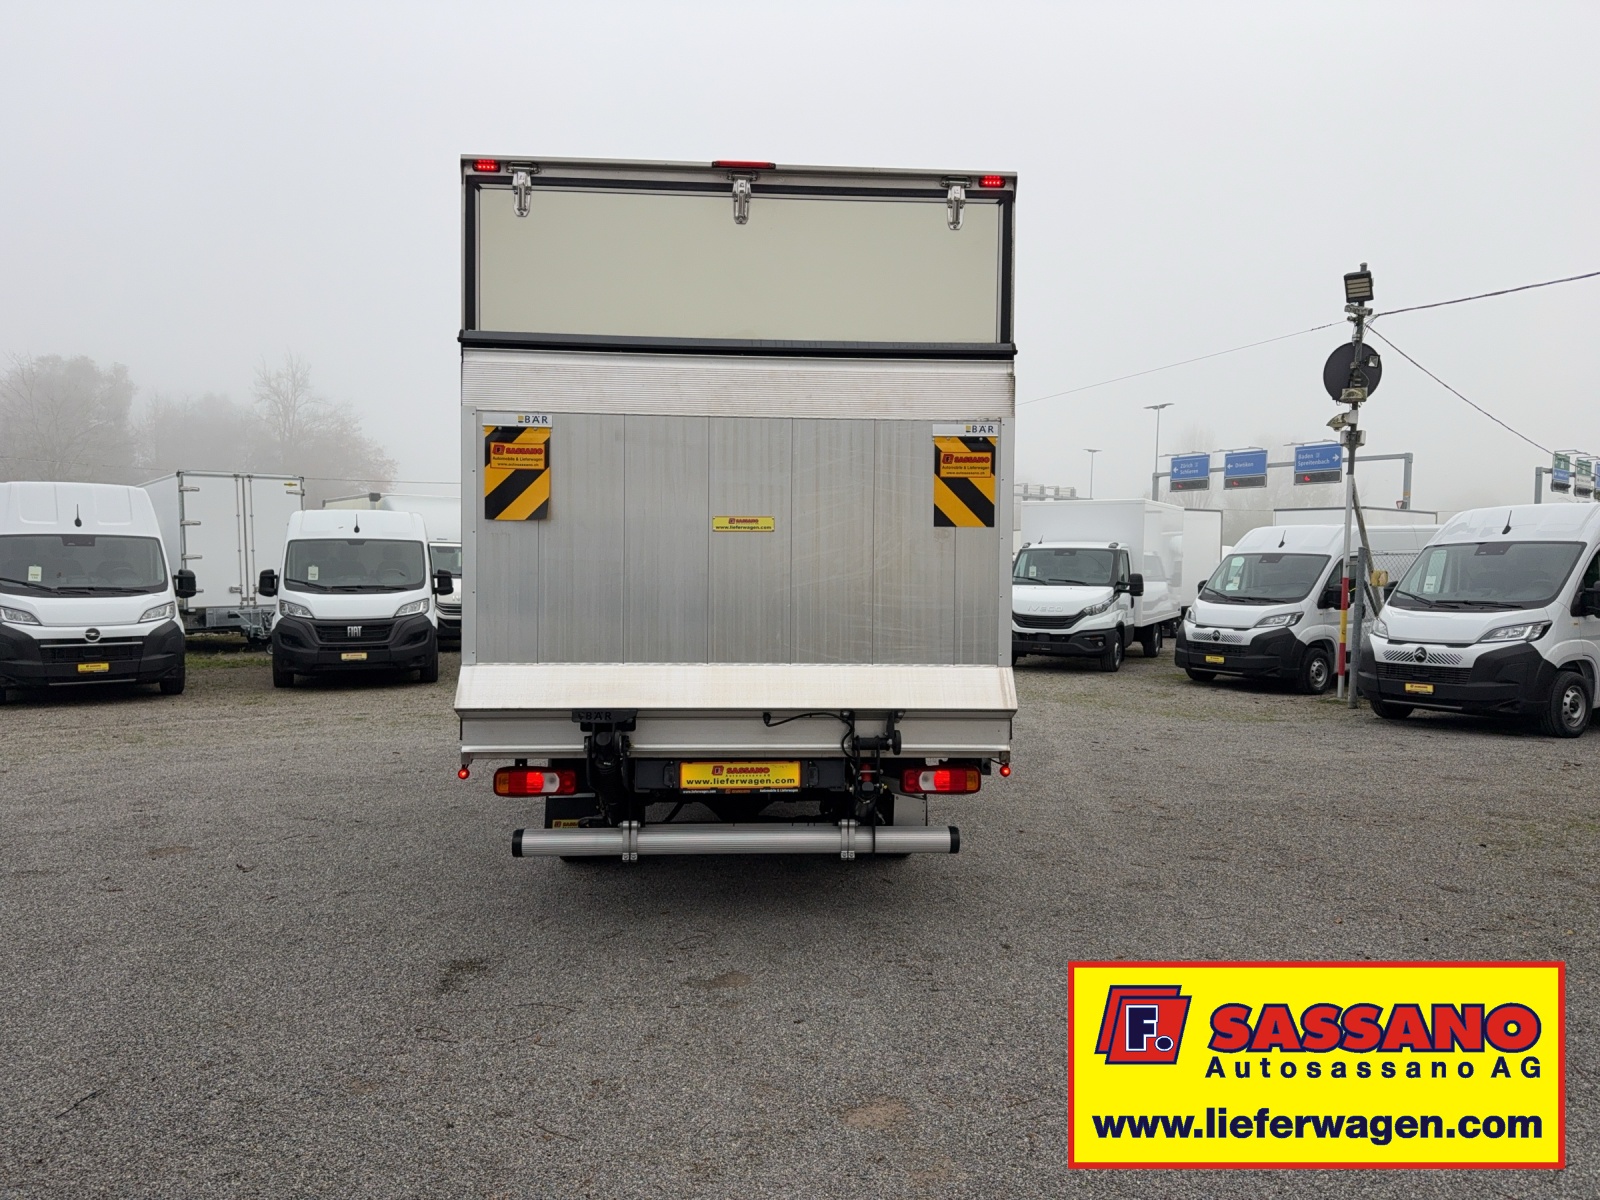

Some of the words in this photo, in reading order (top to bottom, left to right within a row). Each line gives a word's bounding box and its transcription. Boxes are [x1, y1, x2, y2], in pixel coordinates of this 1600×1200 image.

[524, 415, 548, 424] BÄR
[971, 425, 994, 433] BÄR
[505, 447, 544, 455] SASSANO
[1297, 459, 1330, 467] Spreitenbach
[347, 626, 362, 637] FIAT
[586, 711, 612, 720] BÄR
